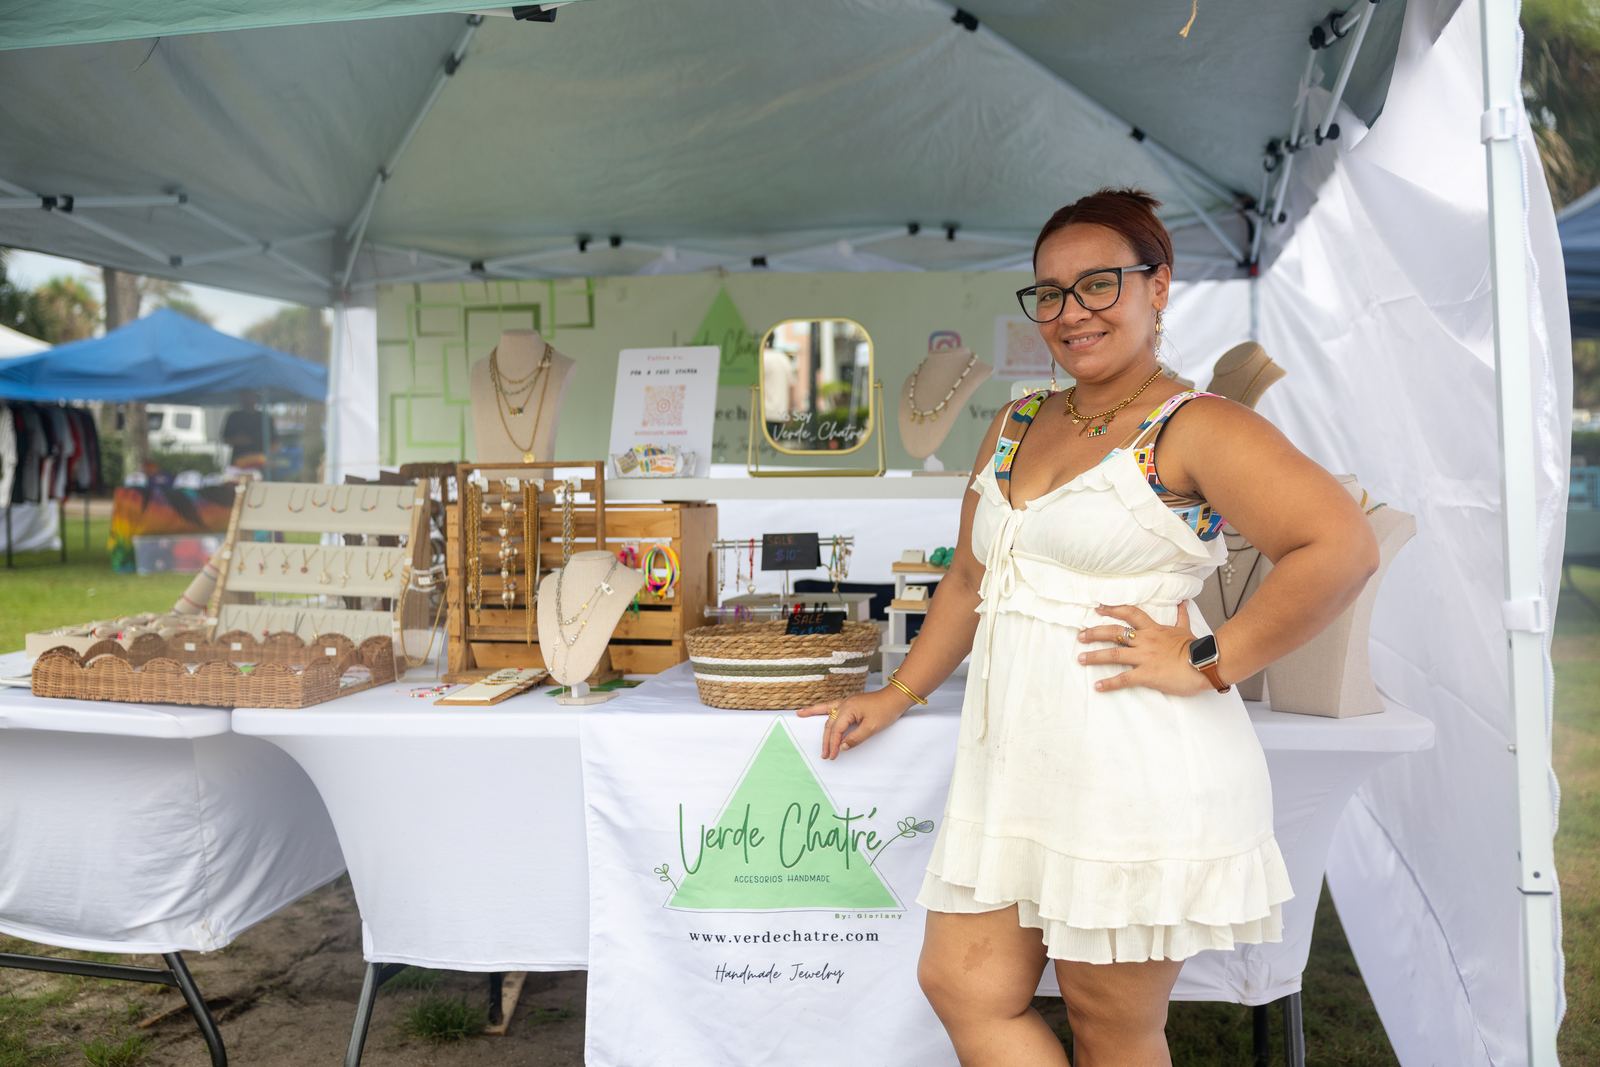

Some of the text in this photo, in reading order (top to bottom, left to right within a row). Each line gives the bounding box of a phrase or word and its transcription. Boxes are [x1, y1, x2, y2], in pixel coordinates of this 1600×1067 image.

[792, 612, 824, 624] SALE
[679, 802, 883, 875] Verde Chatré
[734, 873, 831, 884] ACCESORIOS HANDMADE
[834, 912, 903, 920] By: Gloriany
[688, 929, 880, 945] www.verdechatre.com
[714, 962, 845, 984] Handmade Jewelry
